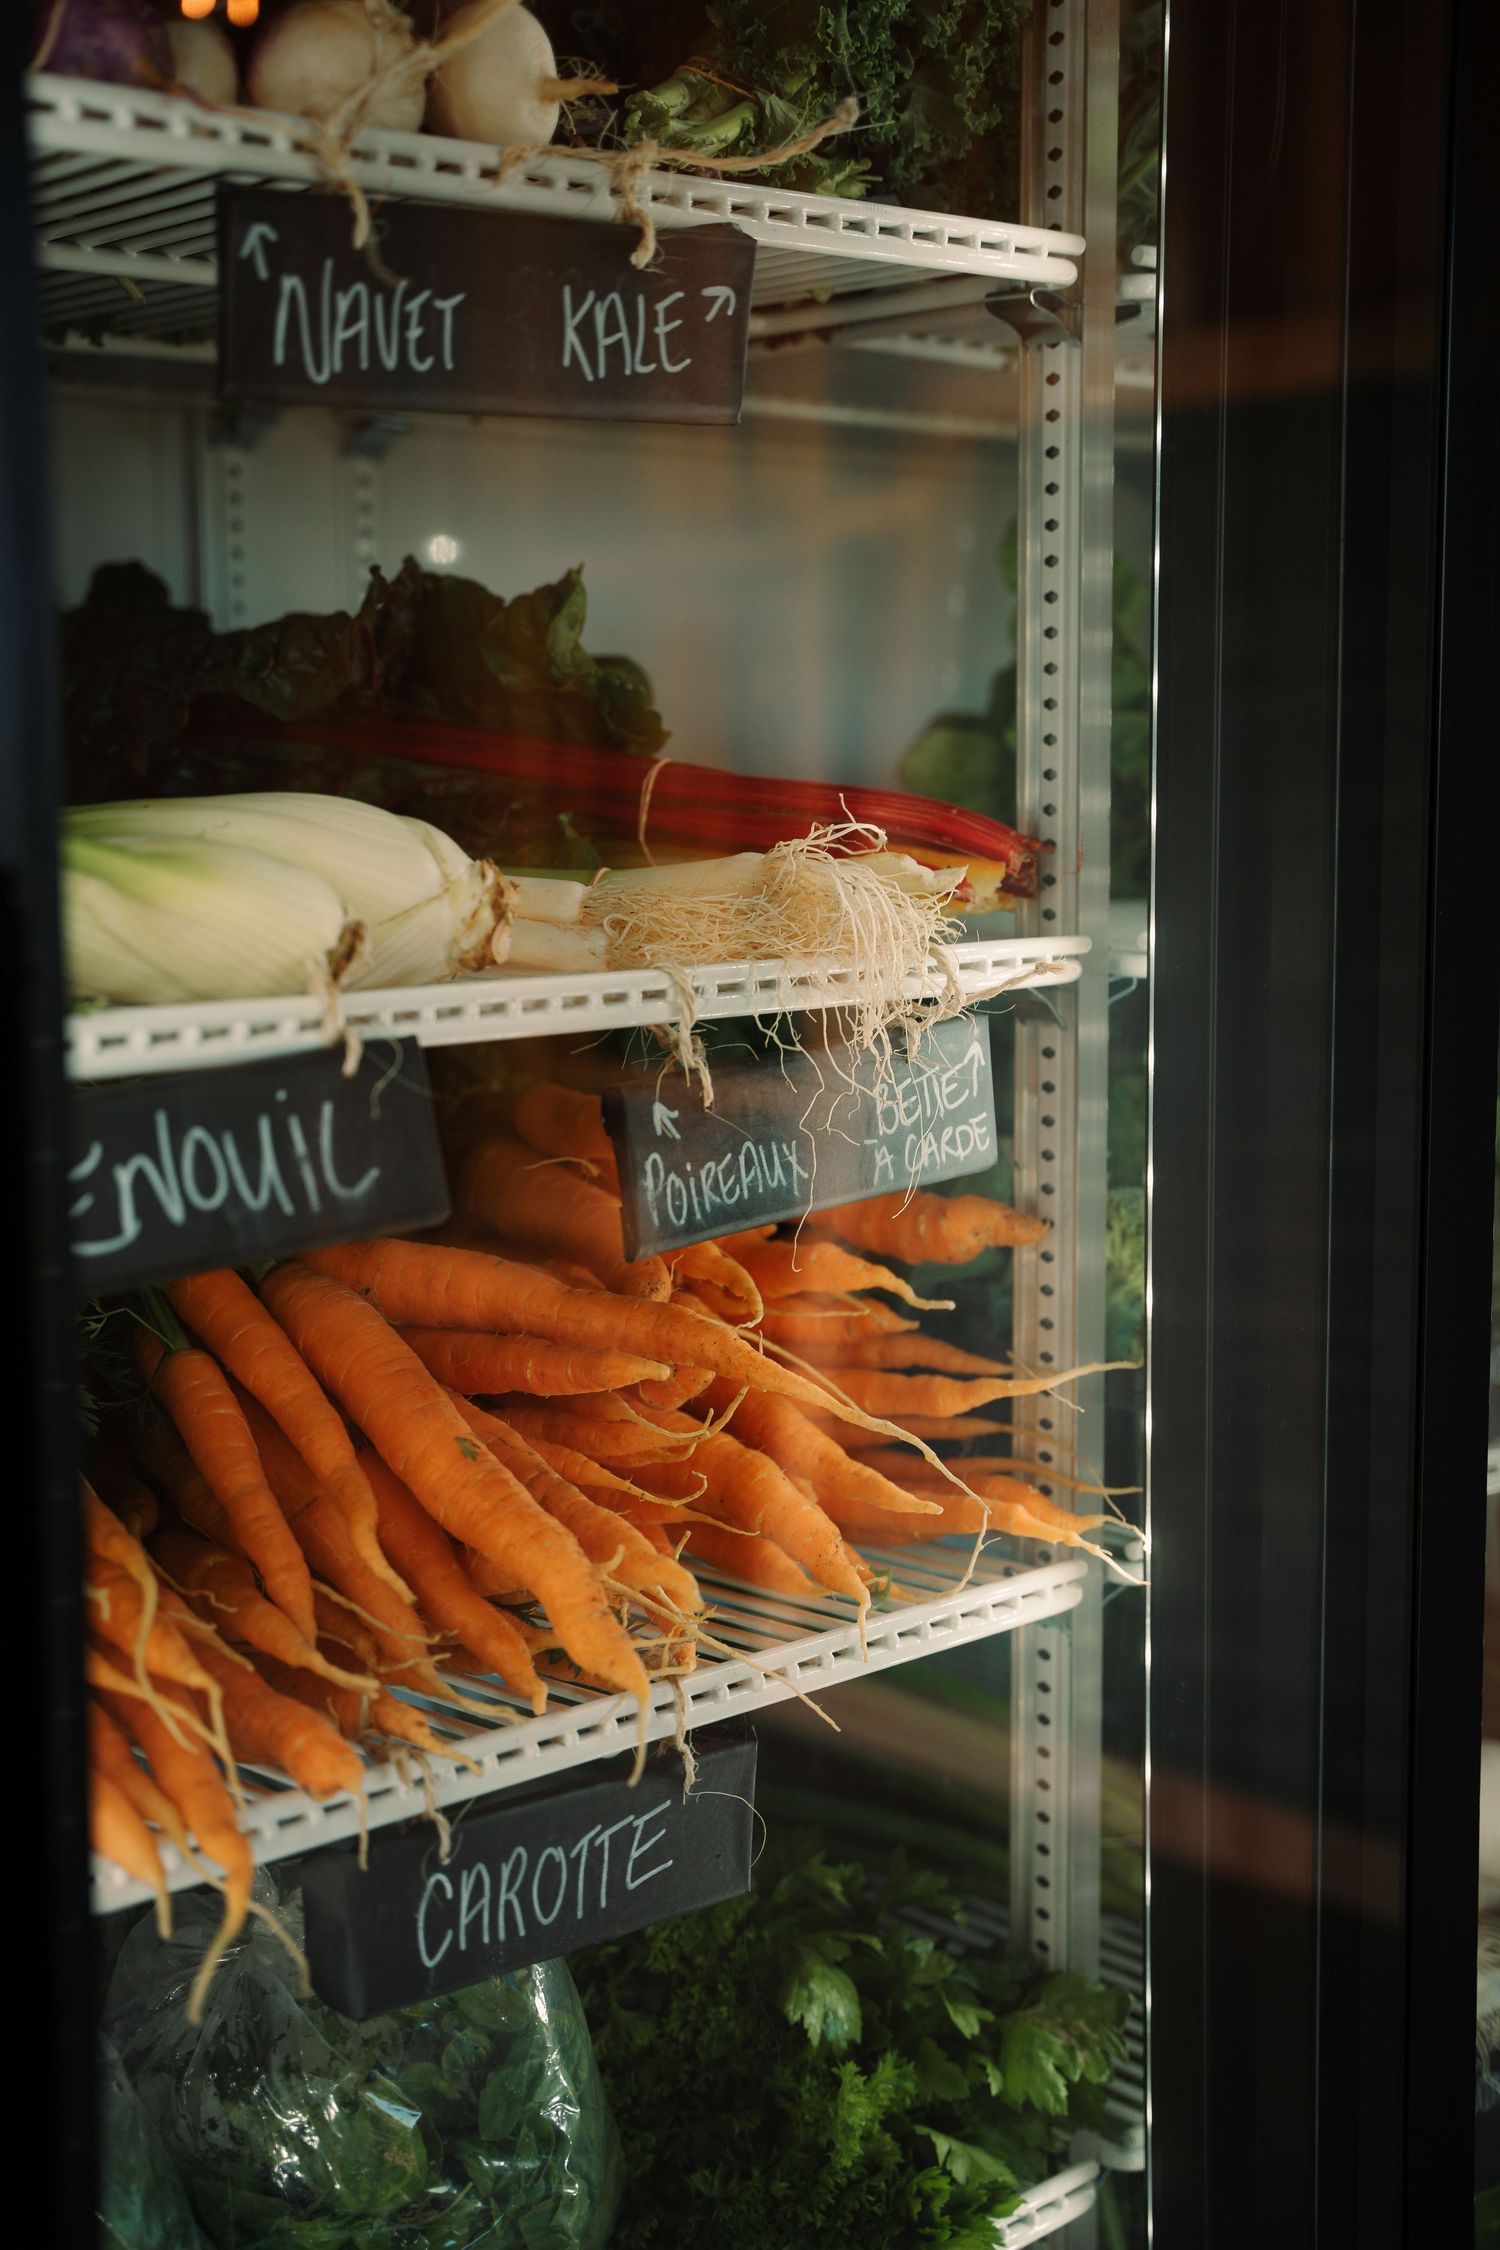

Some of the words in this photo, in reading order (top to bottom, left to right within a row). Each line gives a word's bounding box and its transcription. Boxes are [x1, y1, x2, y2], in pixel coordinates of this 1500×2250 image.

[274, 258, 466, 384] NAVET
[563, 285, 692, 382] KALE
[904, 1111, 991, 1173] CARDE
[417, 1799, 674, 1969] CAROTTE
